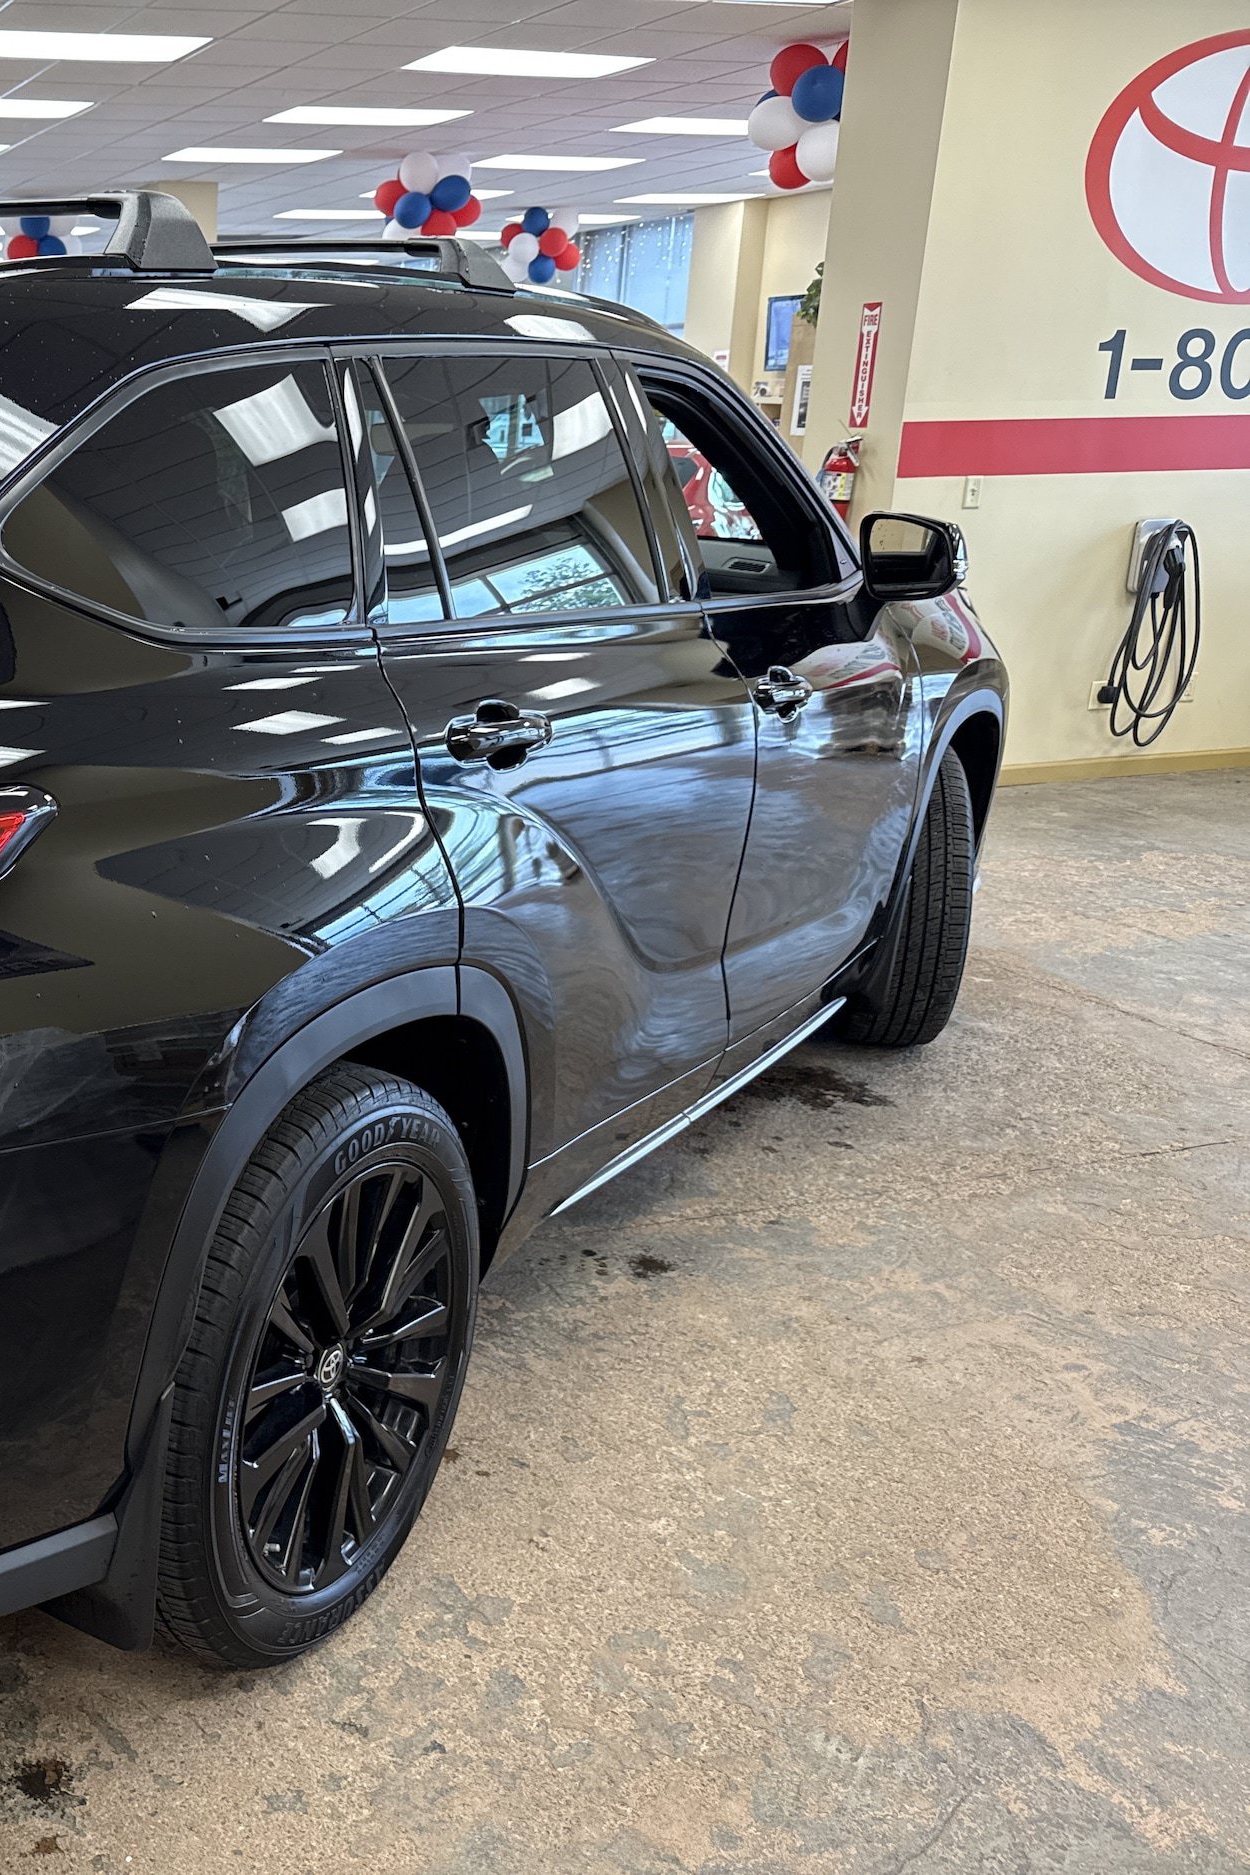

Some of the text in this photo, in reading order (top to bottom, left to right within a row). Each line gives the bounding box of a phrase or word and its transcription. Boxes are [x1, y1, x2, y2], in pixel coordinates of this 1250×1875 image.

[863, 314, 878, 326] FIRE
[856, 330, 872, 419] EXTINGUISHER
[1098, 328, 1250, 400] 1-80
[334, 1116, 441, 1176] GOODYEAR
[277, 1558, 387, 1646] ASSURANCE
